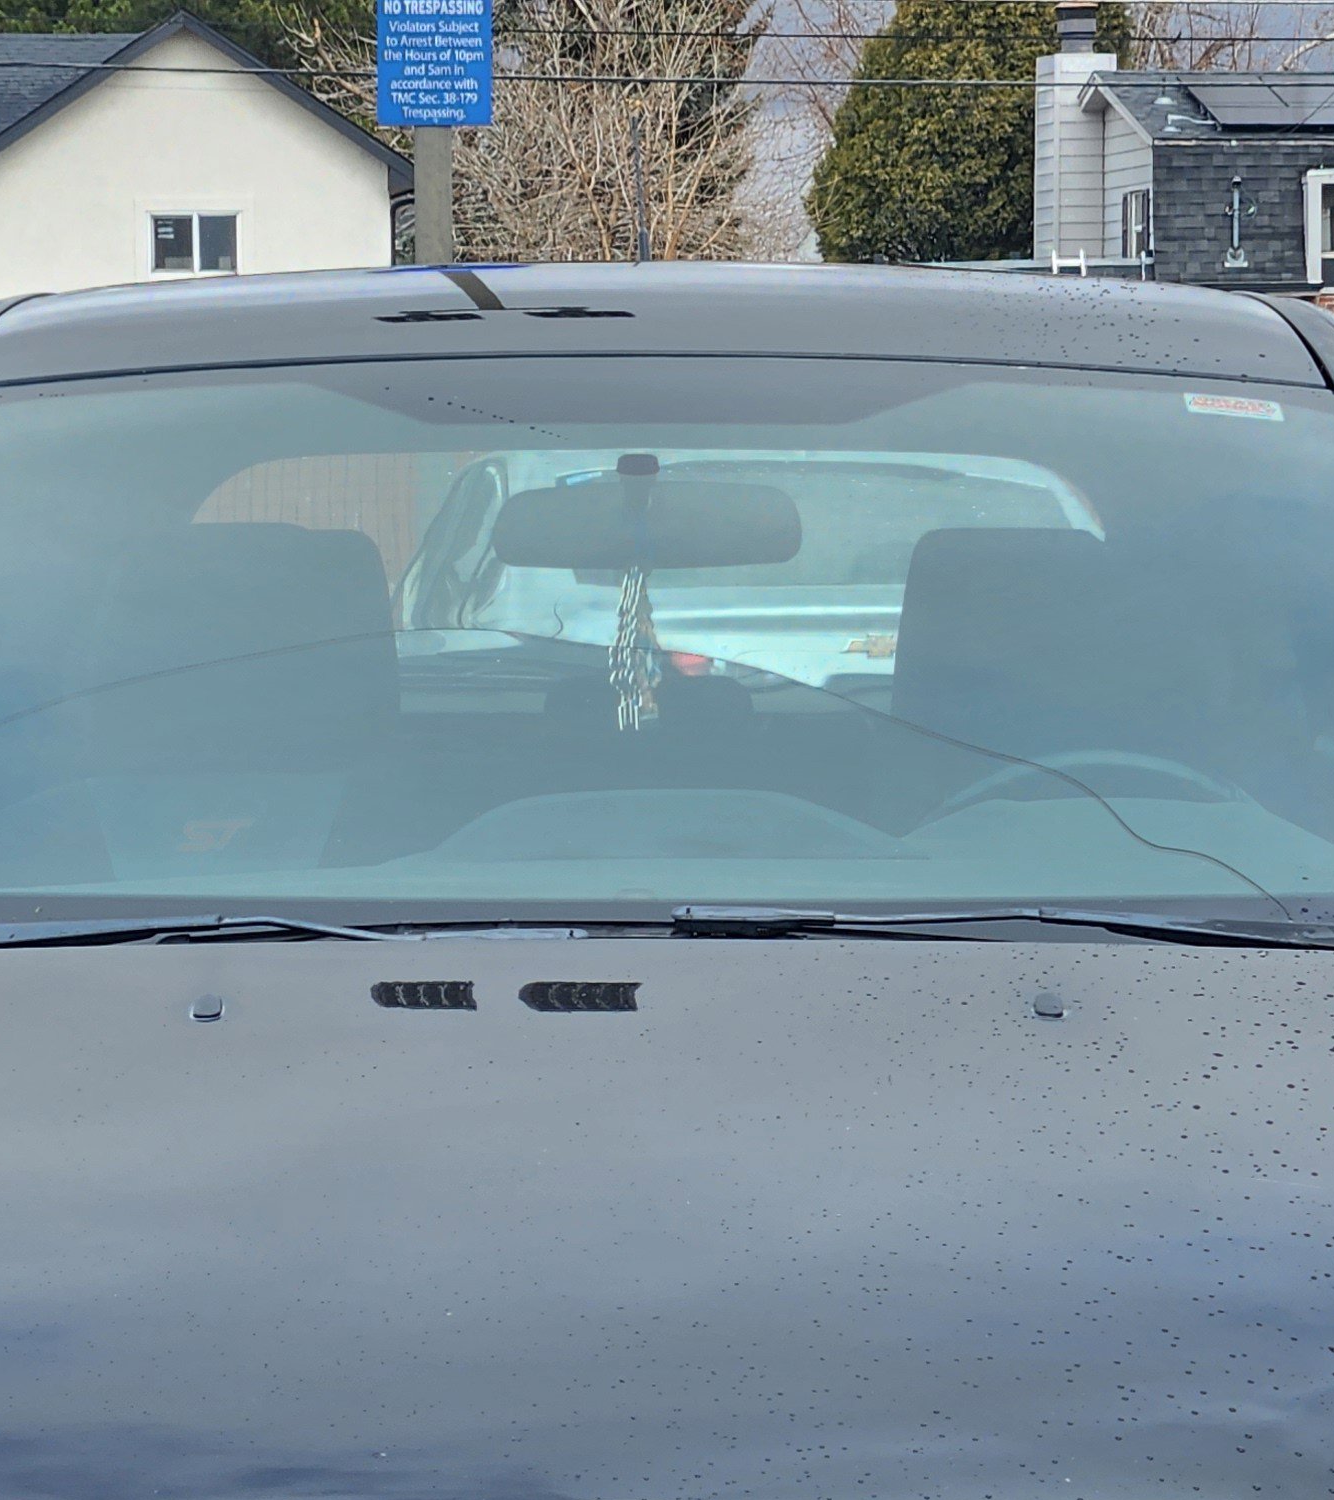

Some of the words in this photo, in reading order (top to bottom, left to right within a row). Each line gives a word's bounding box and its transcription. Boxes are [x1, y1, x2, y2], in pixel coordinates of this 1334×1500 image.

[384, 0, 401, 15] NO
[405, 0, 484, 15] TRESPASSING
[389, 21, 436, 33] Violators
[439, 21, 479, 35] Subject
[386, 37, 398, 47] to
[400, 36, 432, 47] Arrest
[435, 36, 482, 47] Between
[384, 50, 402, 61] the
[405, 50, 437, 61] Hours
[439, 50, 452, 61] of
[454, 50, 484, 63] 10pm
[404, 64, 425, 76] and
[391, 78, 451, 90] accordance
[454, 78, 478, 90] with
[391, 93, 416, 104] TMC
[418, 93, 441, 104] Sec.
[443, 93, 478, 104] 38-179
[402, 106, 466, 121] Trespassing.
